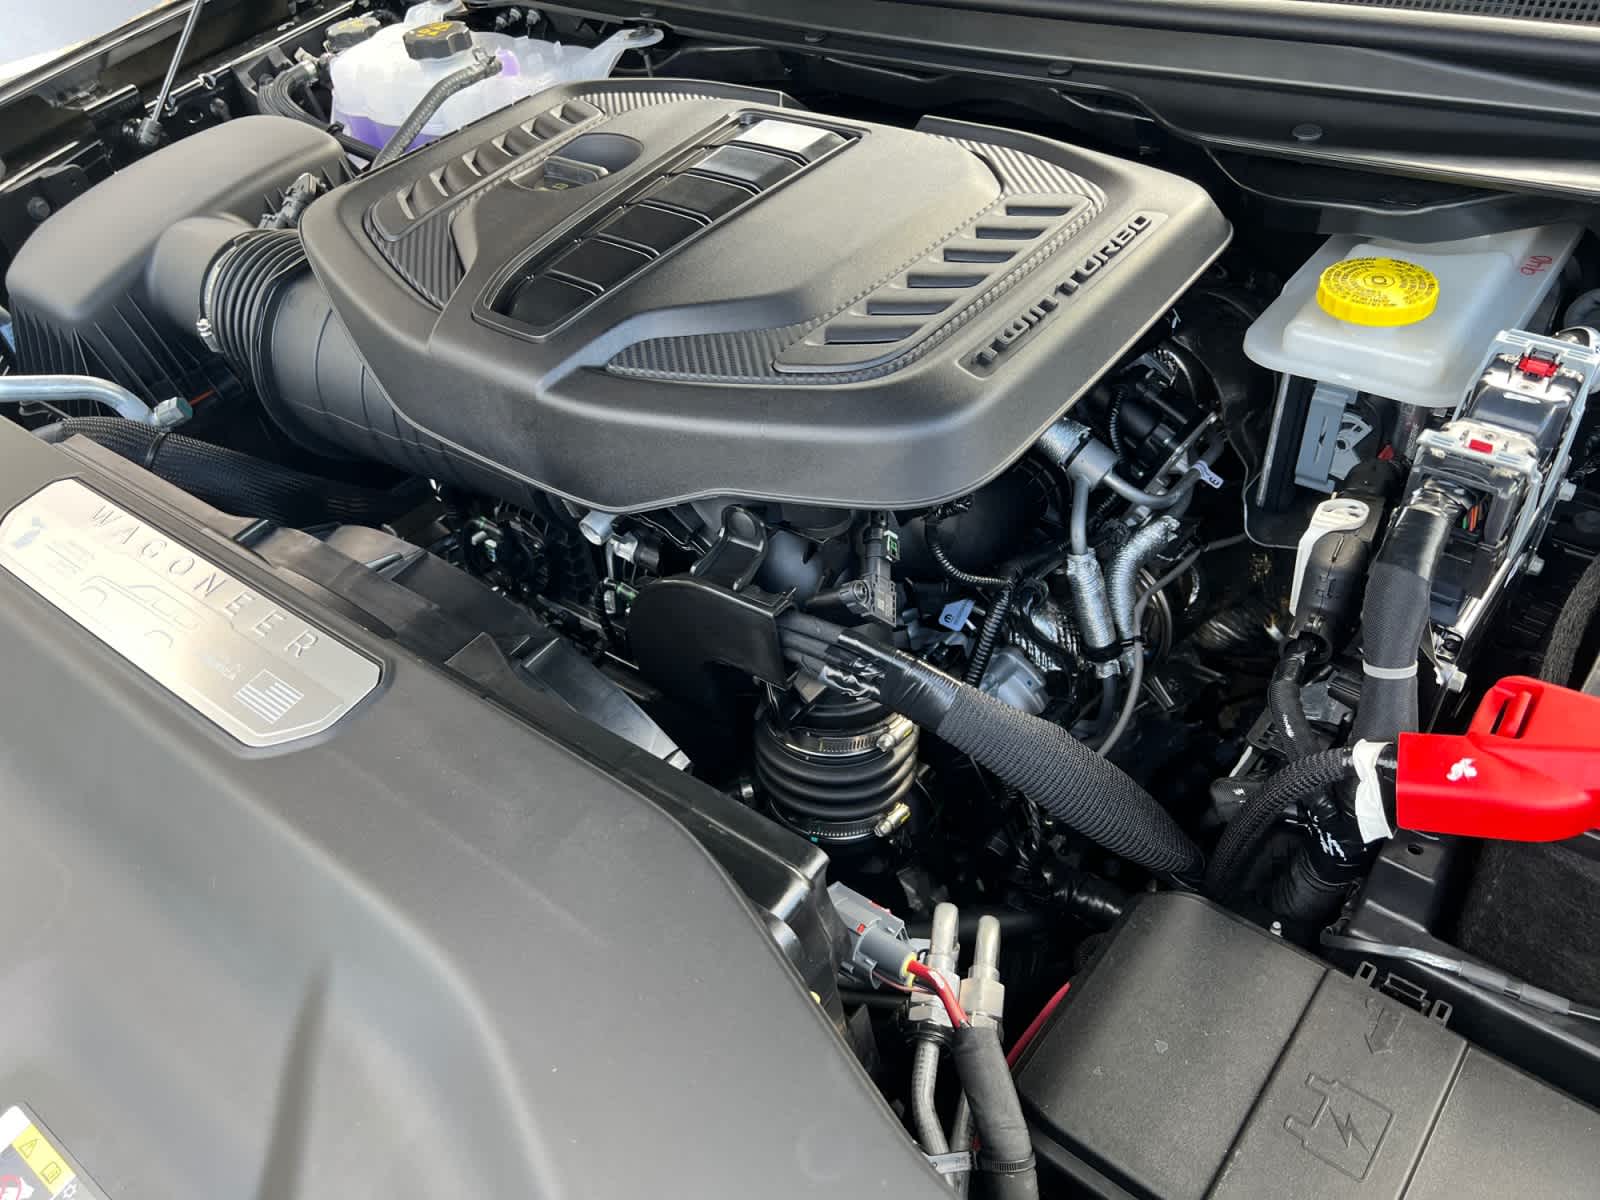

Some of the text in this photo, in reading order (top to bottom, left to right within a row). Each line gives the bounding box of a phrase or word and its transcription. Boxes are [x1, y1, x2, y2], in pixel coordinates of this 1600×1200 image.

[967, 215, 1152, 367] TWIN TURBO
[91, 504, 319, 658] WAGONEER
